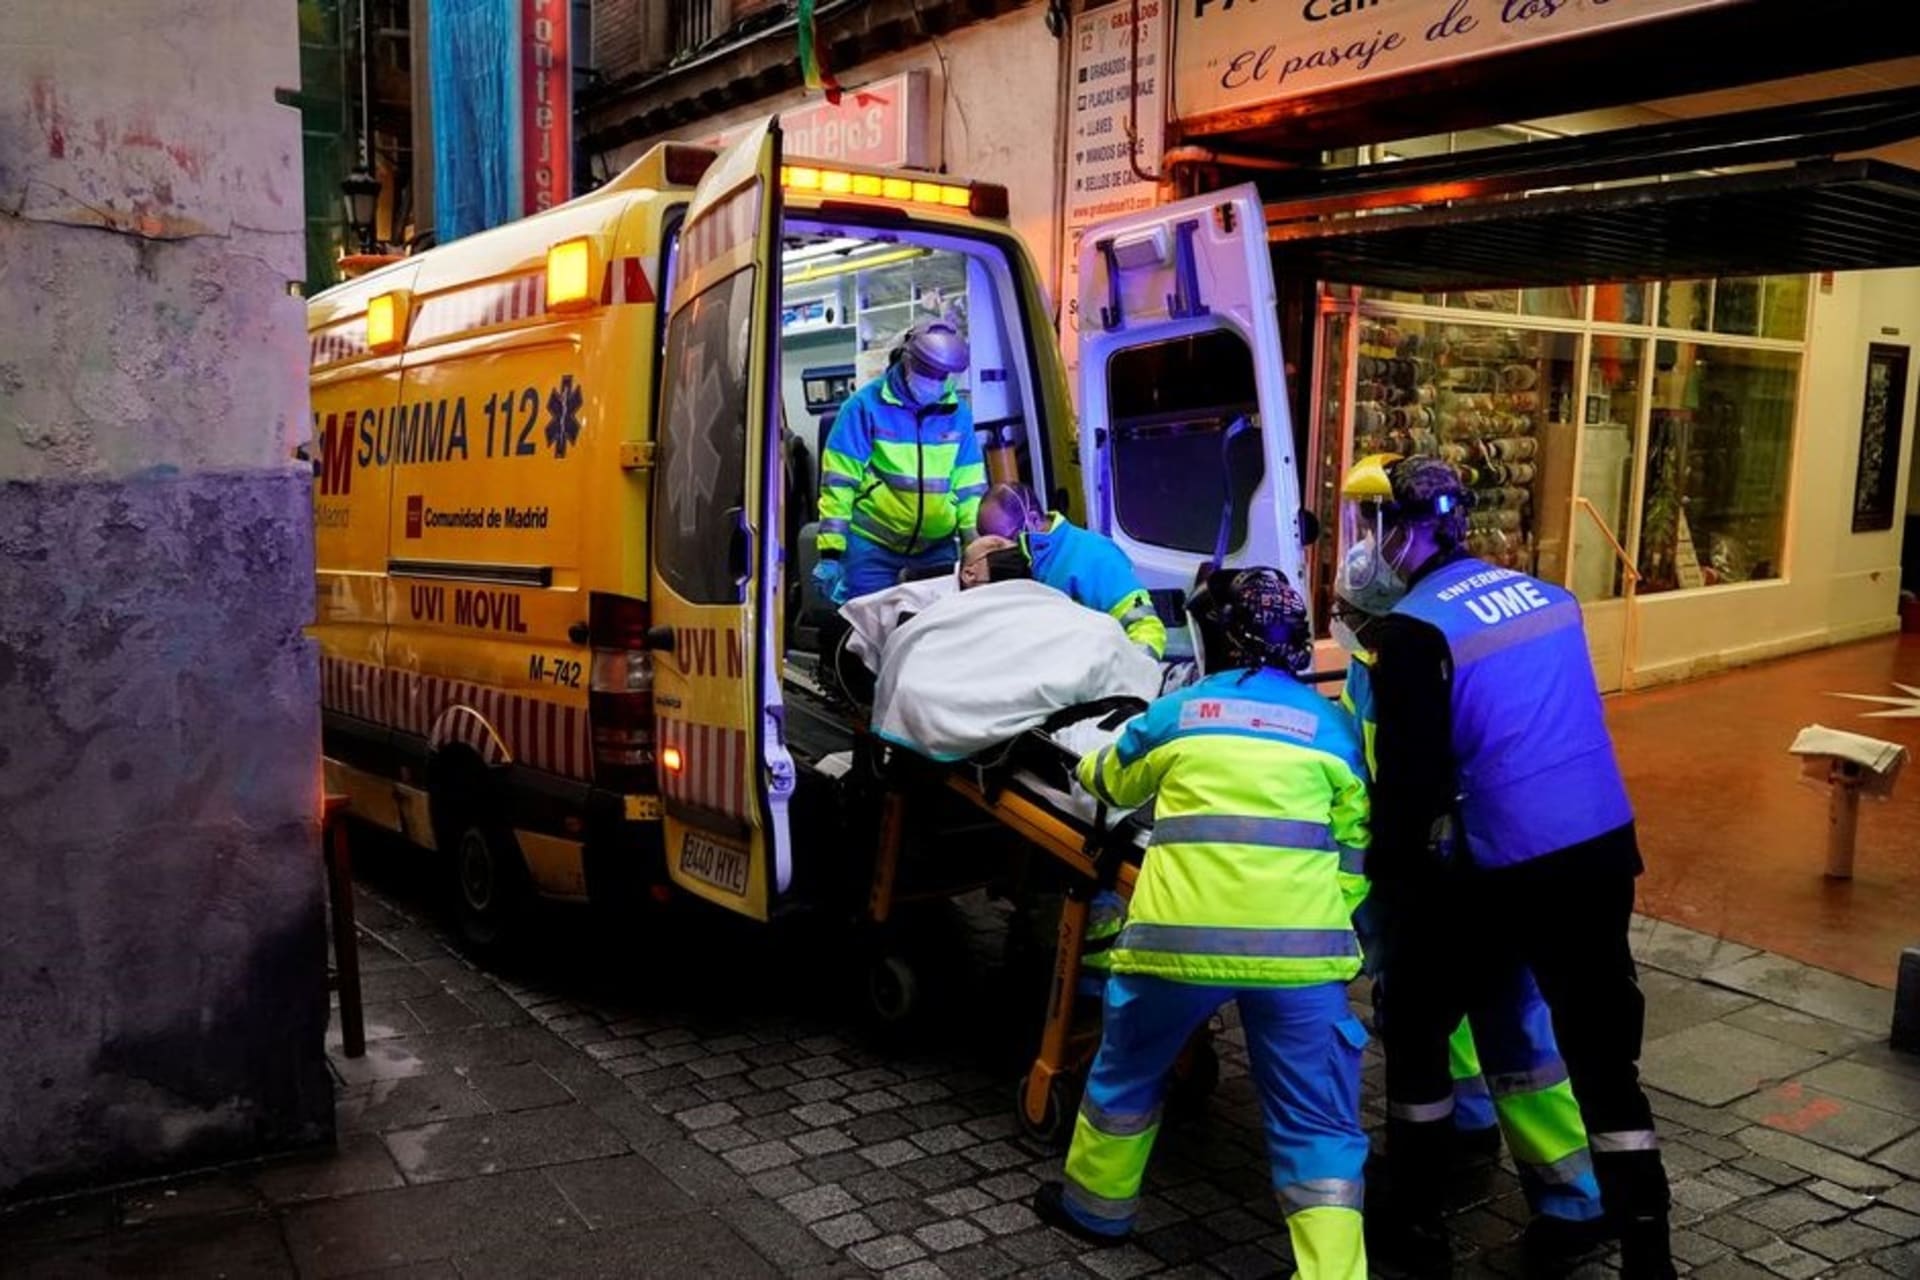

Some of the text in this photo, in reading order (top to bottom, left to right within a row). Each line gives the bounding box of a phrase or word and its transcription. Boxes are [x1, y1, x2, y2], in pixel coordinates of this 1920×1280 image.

[1278, 29, 1407, 84] pasaje
[1425, 0, 1479, 41] de
[358, 396, 469, 468] SUMMA
[483, 387, 540, 460] 112
[424, 506, 549, 529] Comunidad de Madrid
[410, 584, 528, 634] UVI MOVIL
[1464, 580, 1551, 625] UME
[676, 626, 717, 678] UVI
